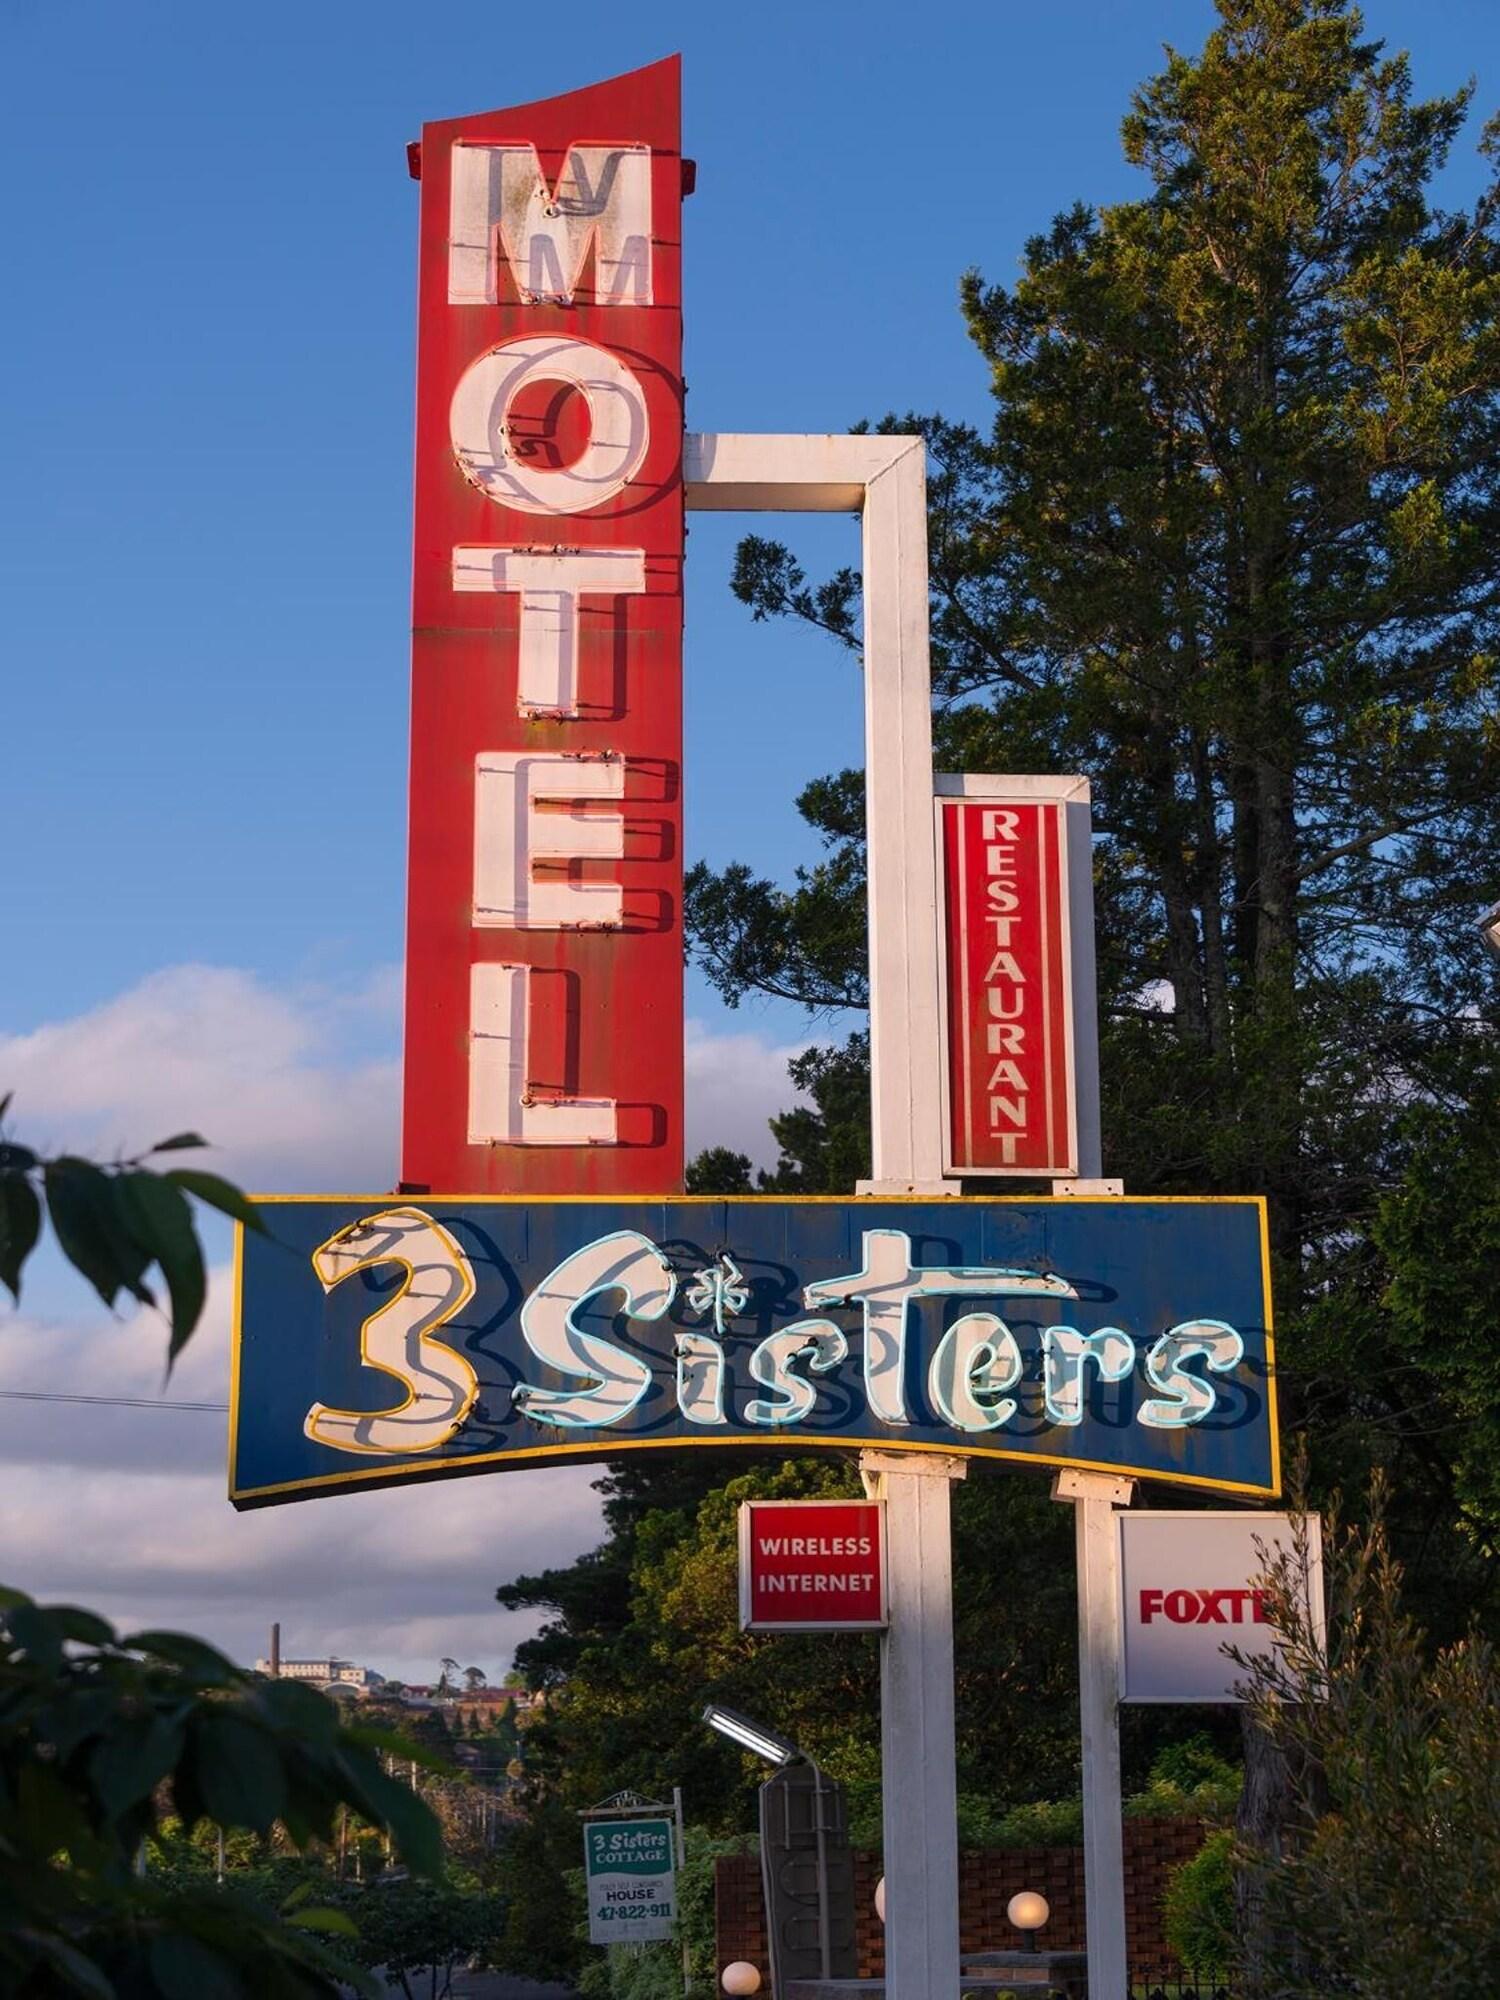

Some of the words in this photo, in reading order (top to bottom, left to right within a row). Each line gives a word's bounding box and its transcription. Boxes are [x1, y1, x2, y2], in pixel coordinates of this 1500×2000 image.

[447, 139, 655, 1148] MOTEL
[981, 809, 1030, 1164] RESTAURANT
[302, 1206, 480, 1456] 3
[510, 1228, 1246, 1433] Sisters
[758, 1537, 872, 1556] WIRELESS
[758, 1573, 874, 1593] INTERNET
[1139, 1589, 1289, 1625] FOXTE
[593, 1834, 606, 1851] 3
[609, 1831, 667, 1850] Sisters
[595, 1850, 666, 1864] COTTAGE
[606, 1888, 656, 1902] HOUSE
